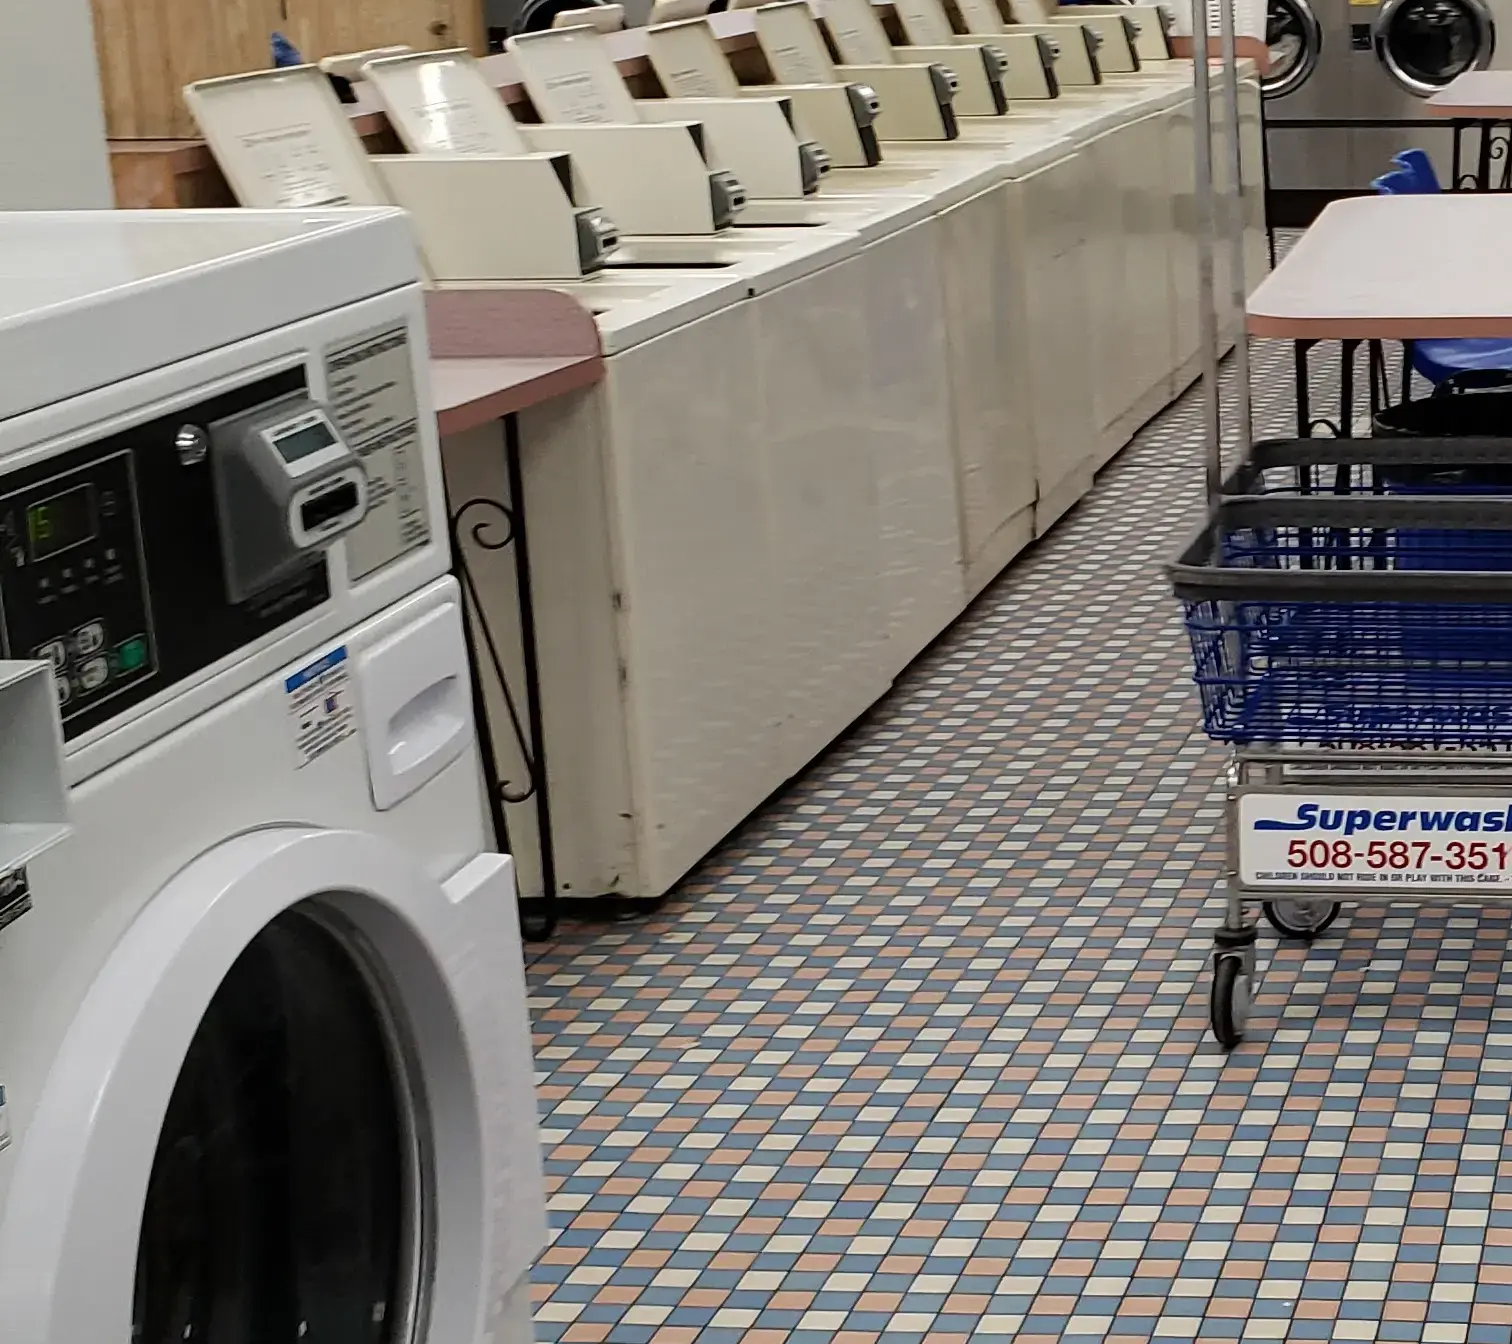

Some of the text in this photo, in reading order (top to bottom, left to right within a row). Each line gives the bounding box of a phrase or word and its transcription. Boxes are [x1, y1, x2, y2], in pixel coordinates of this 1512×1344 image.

[1300, 872, 1335, 881] SHOULD
[1337, 872, 1354, 881] NOT
[1405, 873, 1427, 882] PLAY
[1430, 873, 1453, 883] WITH
[1455, 874, 1475, 883] THIS
